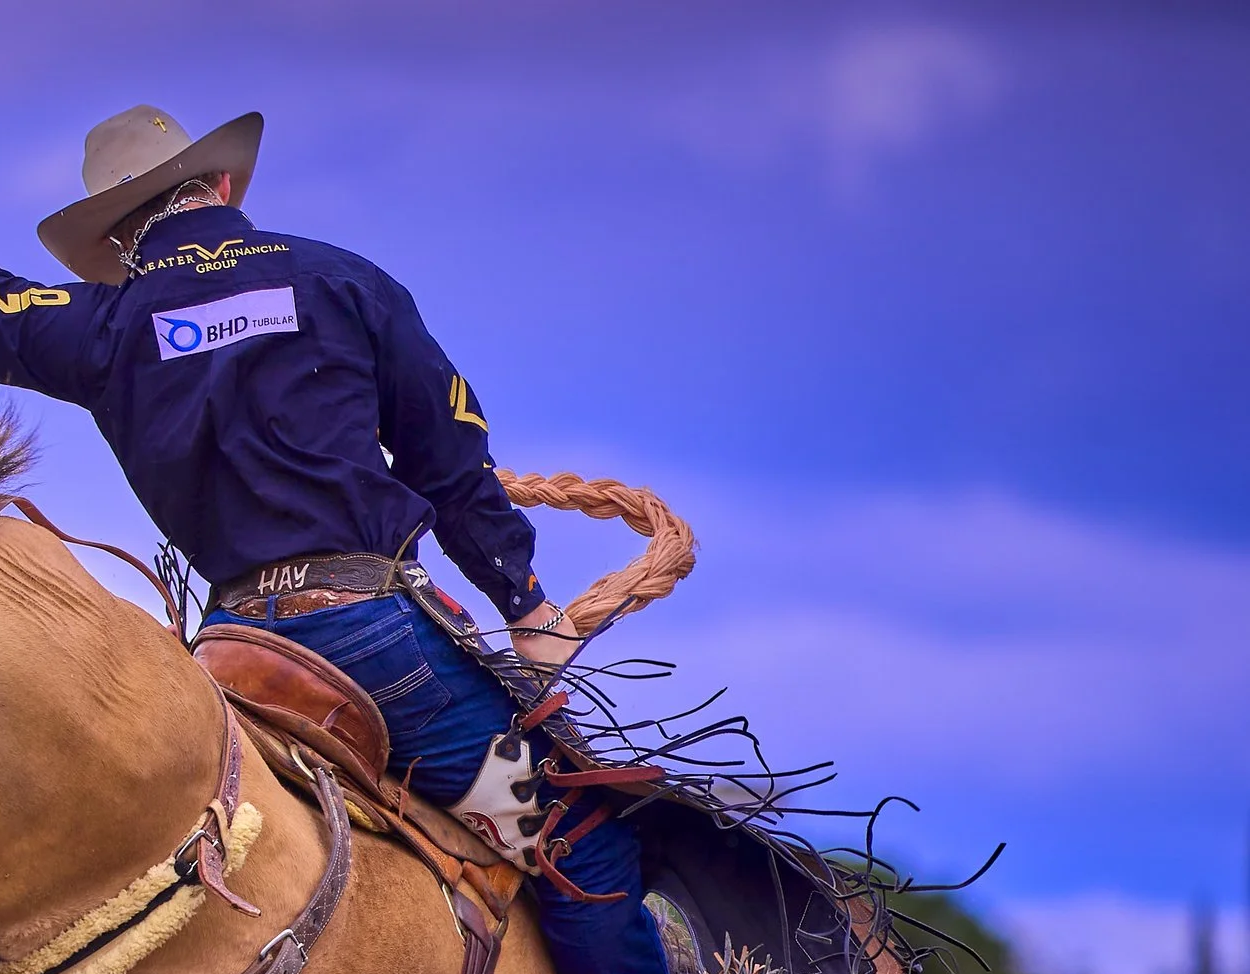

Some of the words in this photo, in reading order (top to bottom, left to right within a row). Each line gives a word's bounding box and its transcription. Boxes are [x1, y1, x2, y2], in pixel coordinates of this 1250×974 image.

[142, 254, 195, 275] EATER
[222, 243, 290, 260] FINANCIAL
[195, 259, 238, 274] GROUP
[206, 315, 248, 343] BHD
[251, 314, 295, 329] TUBULAR
[257, 562, 310, 595] HAY
